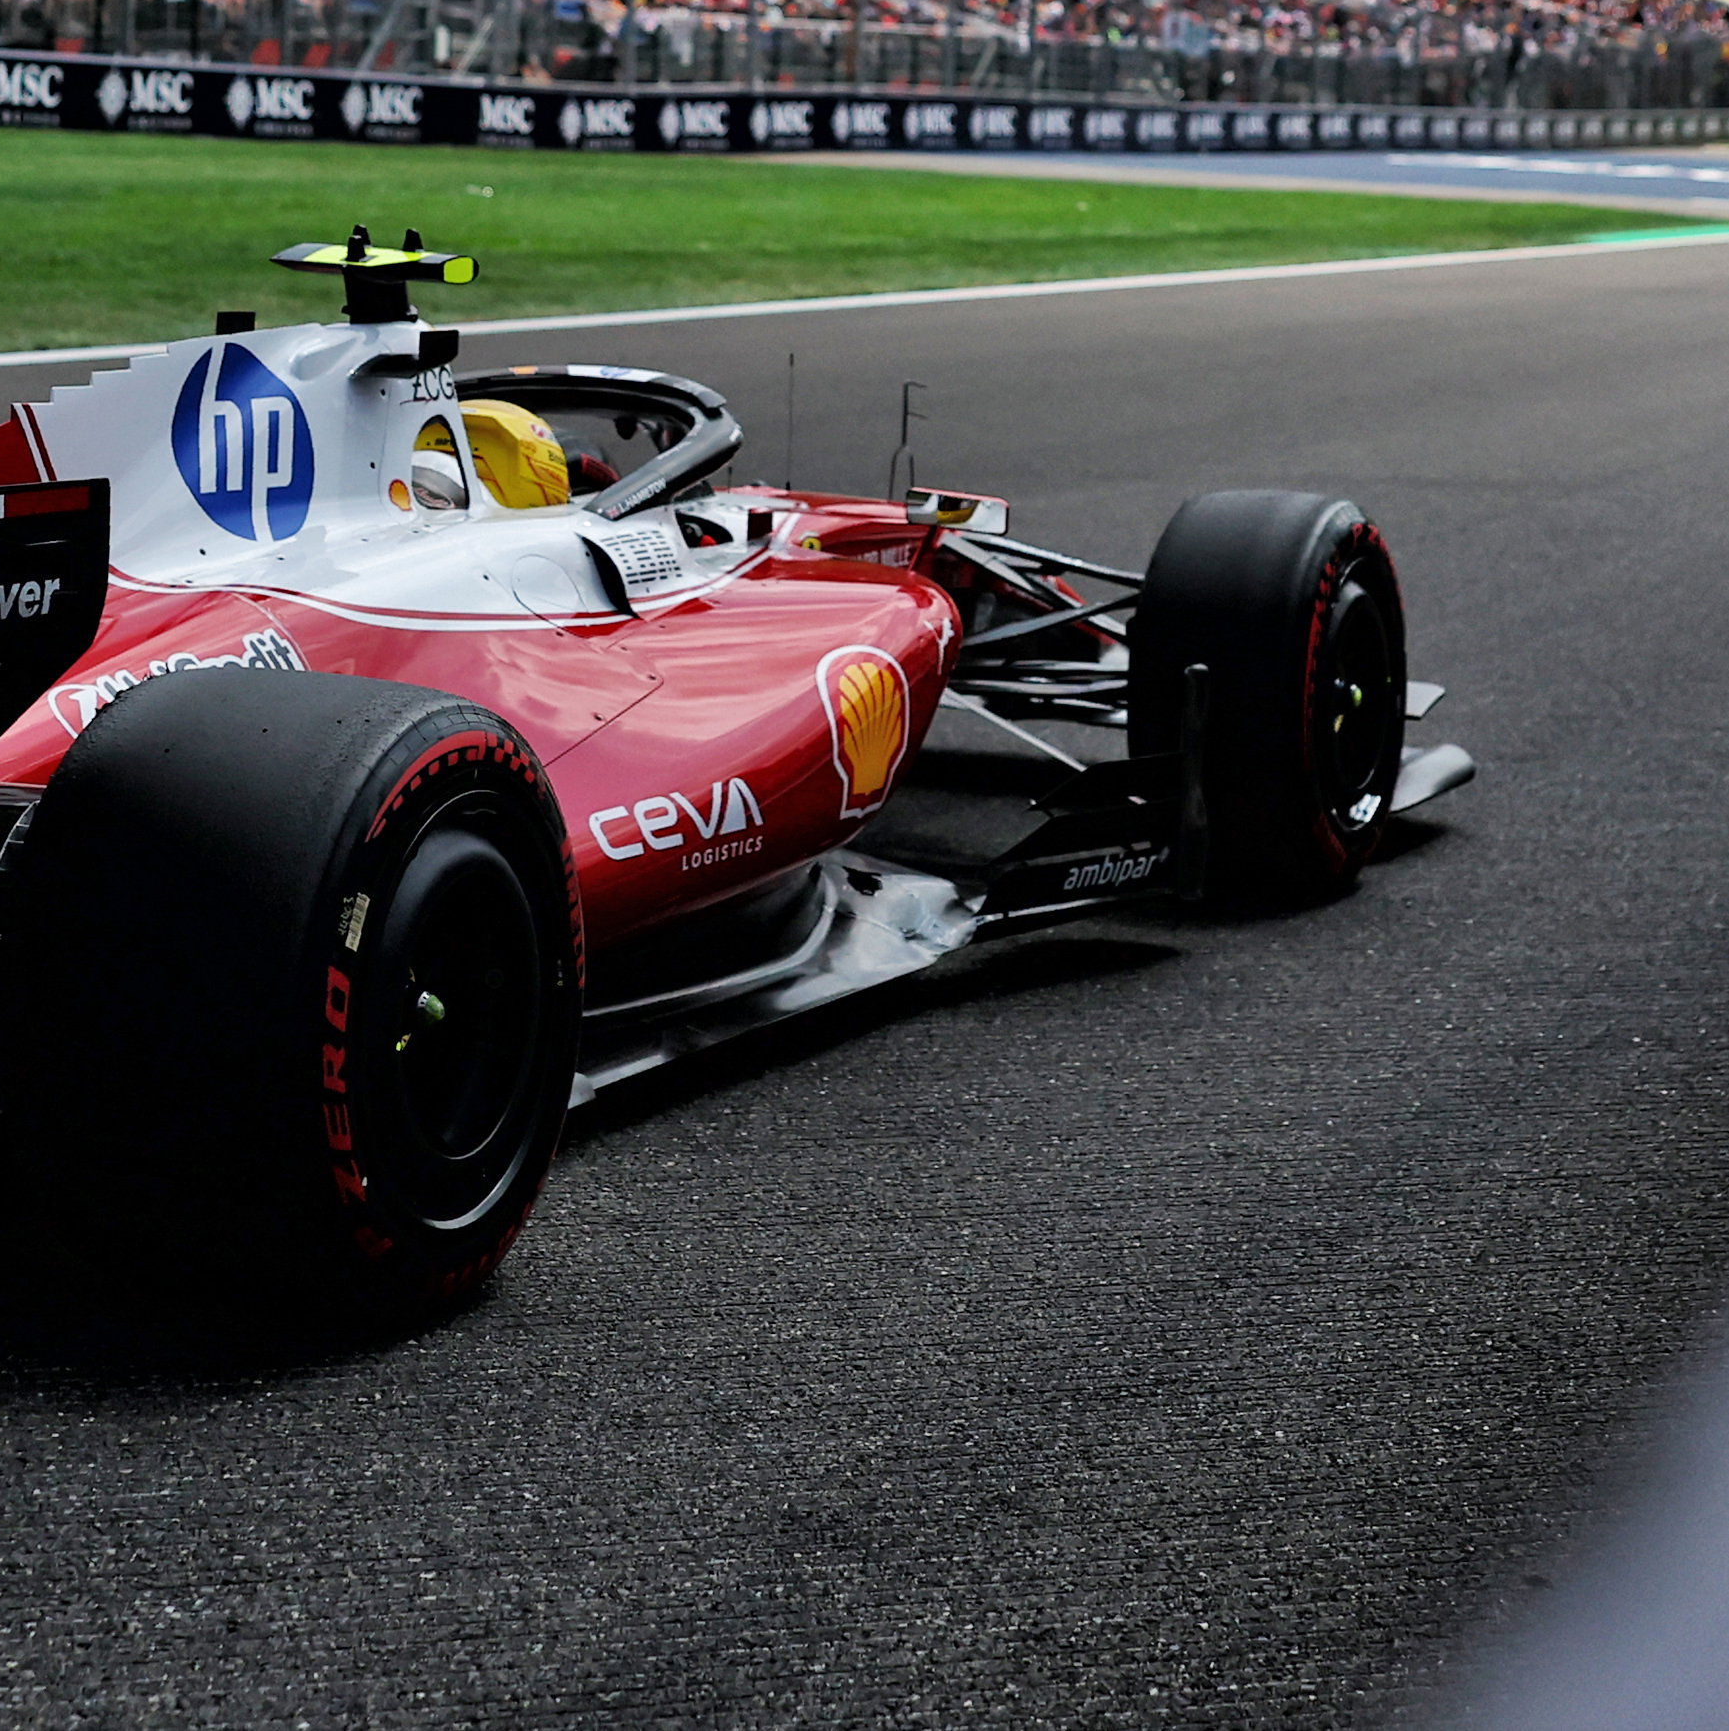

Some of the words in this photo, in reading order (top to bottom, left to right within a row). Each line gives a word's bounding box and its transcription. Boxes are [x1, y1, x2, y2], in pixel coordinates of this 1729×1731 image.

[130, 71, 194, 114] MSC
[255, 78, 314, 120] MSC
[368, 85, 423, 125] MSC
[479, 94, 535, 134] MSC
[198, 343, 294, 540] hp
[682, 836, 763, 871] LOGISTICS
[1063, 852, 1158, 890] ambipar
[322, 965, 367, 1205] ZERO
